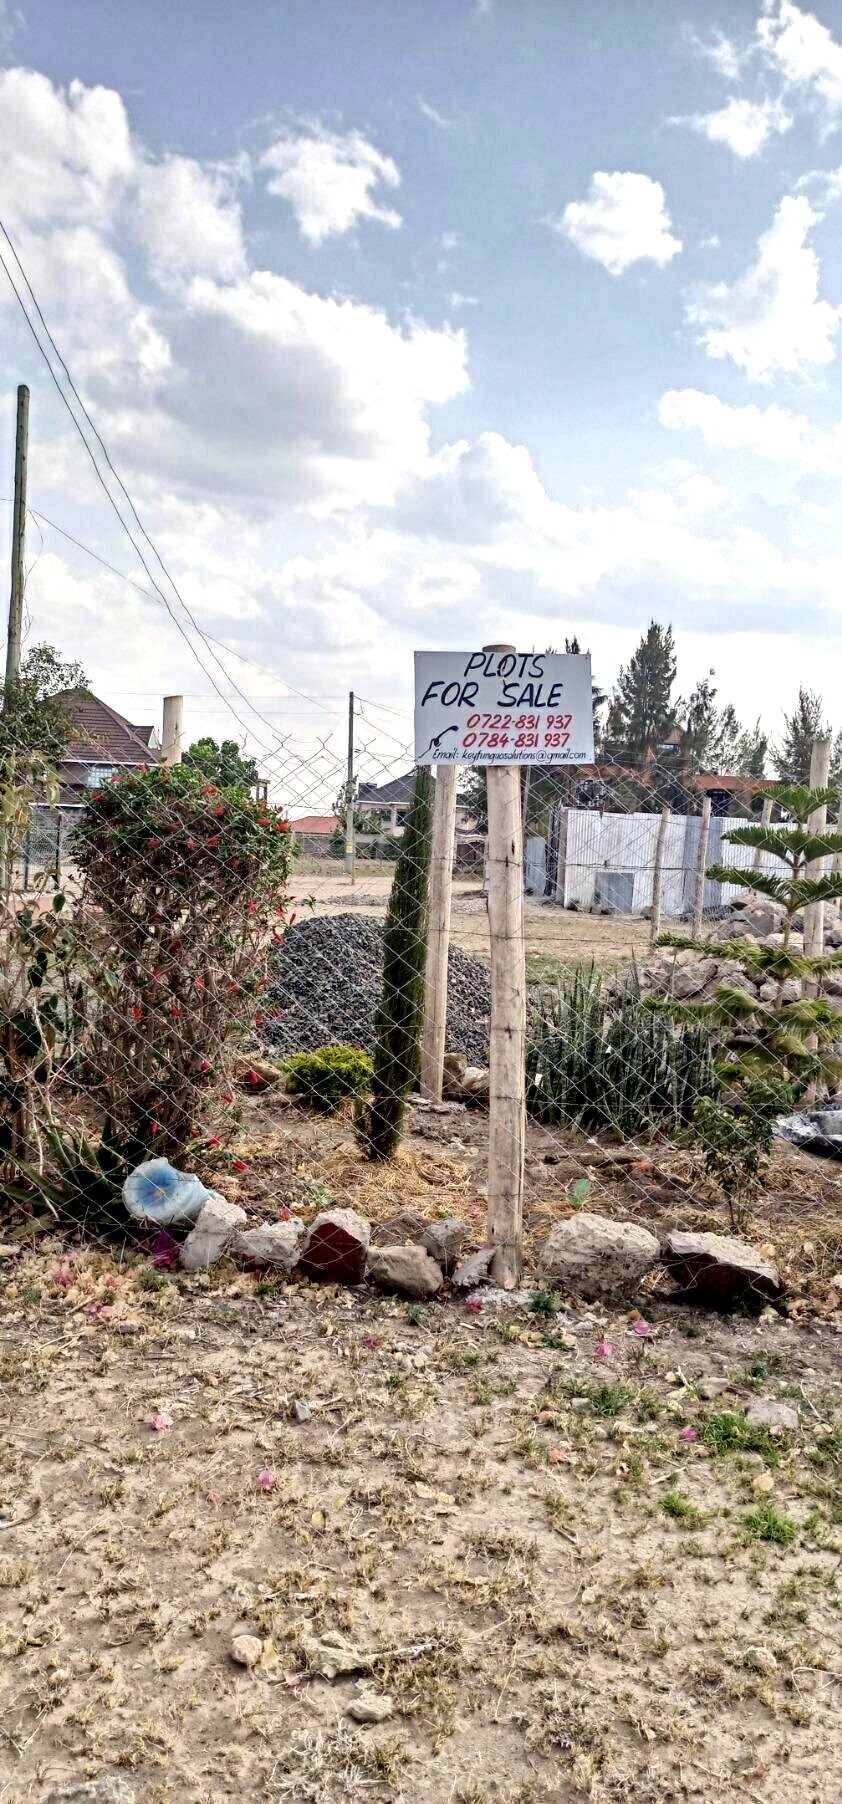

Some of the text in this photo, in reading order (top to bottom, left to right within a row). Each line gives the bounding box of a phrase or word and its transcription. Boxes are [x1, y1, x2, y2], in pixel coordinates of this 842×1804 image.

[464, 652, 546, 678] PLOTS
[421, 681, 563, 707] FOR SALE
[466, 714, 573, 730] 0722-831 937
[462, 732, 571, 748] 0784-831 937
[432, 748, 459, 760] Email:
